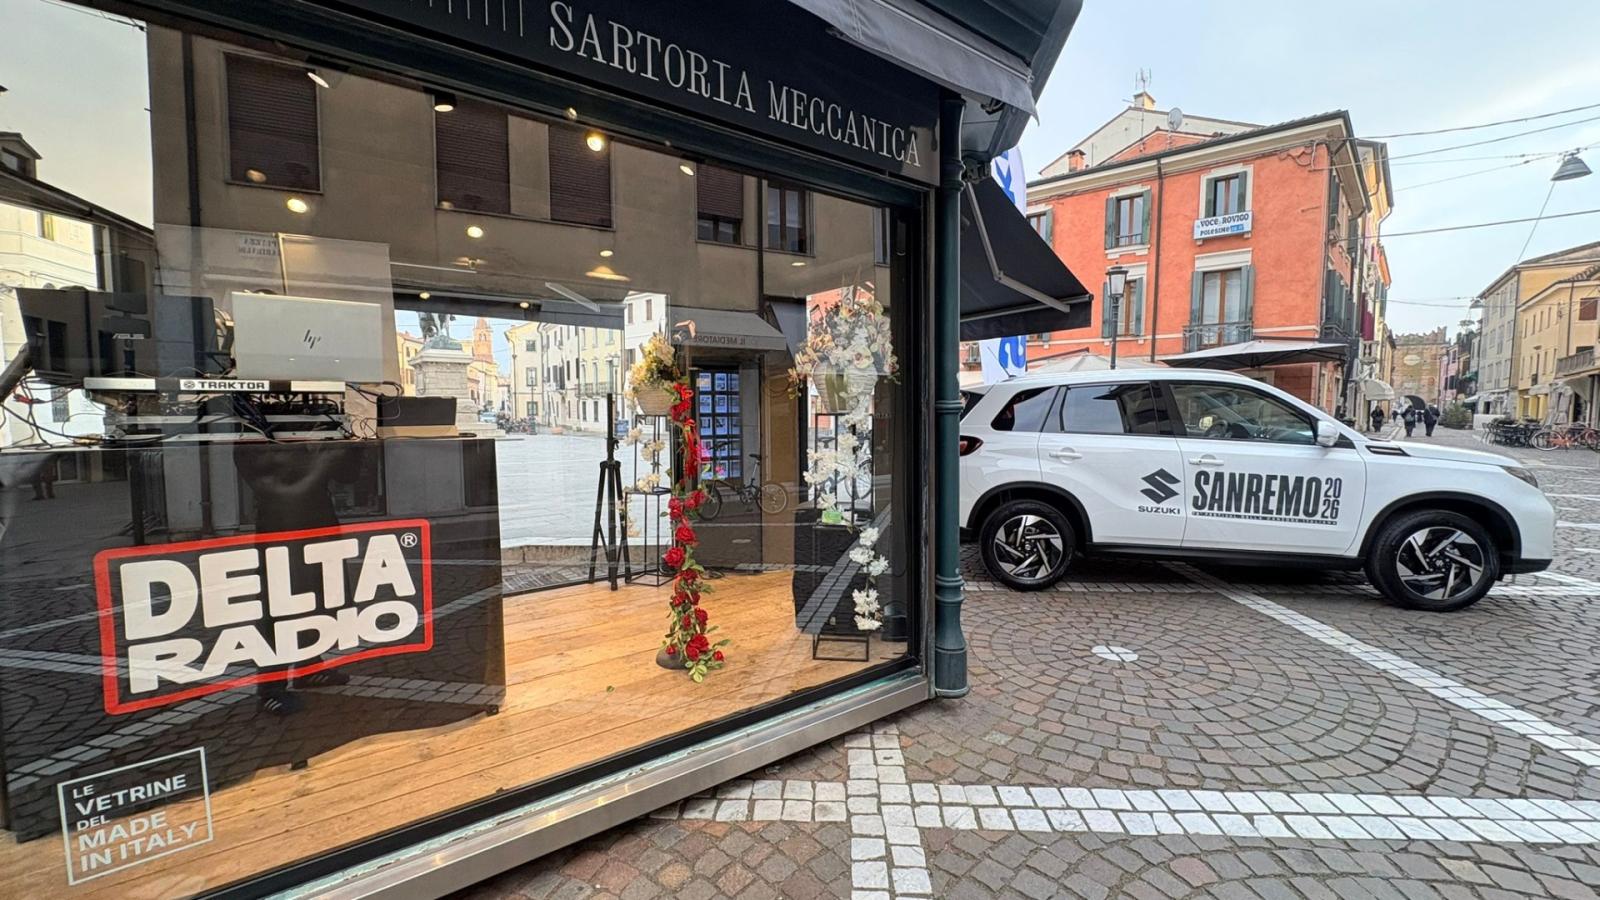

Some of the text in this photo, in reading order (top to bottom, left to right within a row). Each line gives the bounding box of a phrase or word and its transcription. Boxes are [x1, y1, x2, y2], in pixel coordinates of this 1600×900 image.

[550, 1, 921, 167] SARTORIA MECCANICA
[199, 381, 265, 390] TRAKTOR
[1192, 470, 1322, 518] SANREMO
[1324, 477, 1342, 498] 20
[1138, 506, 1180, 515] SUZUKI
[1321, 499, 1340, 520] 26
[120, 534, 416, 640] DELTA
[128, 601, 418, 694] RADIO
[73, 784, 94, 799] LE
[75, 774, 187, 816] VETRINE
[76, 815, 111, 832] DEL
[78, 811, 168, 852] MADE
[80, 822, 197, 872] IN ITALY
